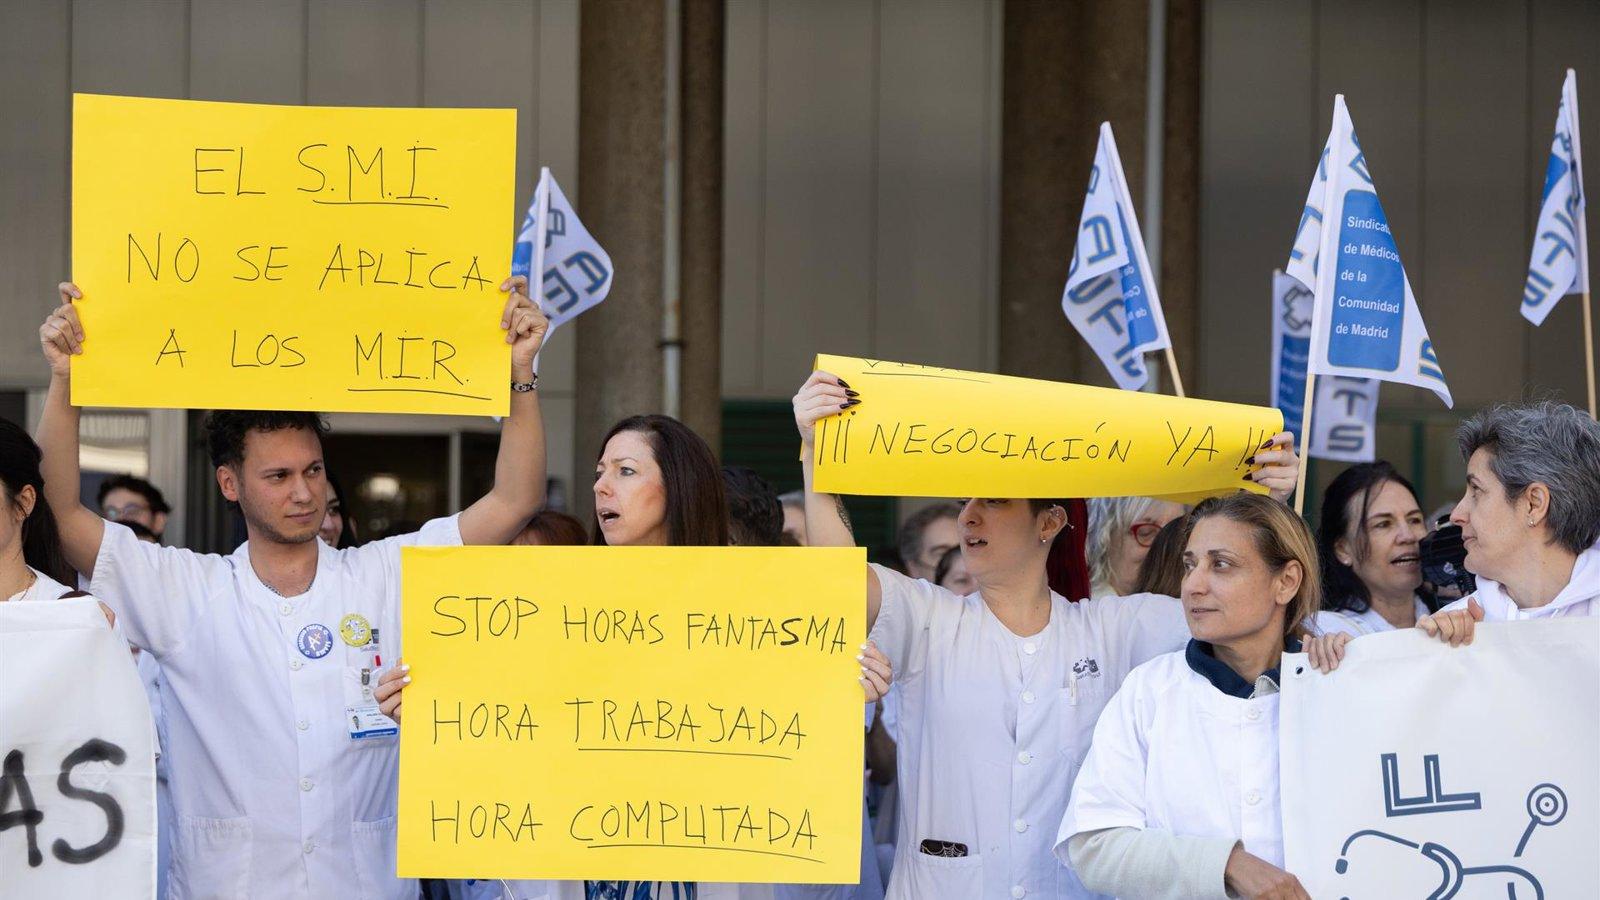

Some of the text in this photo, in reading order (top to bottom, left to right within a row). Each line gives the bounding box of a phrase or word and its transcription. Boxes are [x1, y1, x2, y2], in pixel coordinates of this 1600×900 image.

[195, 147, 266, 196] EL
[128, 233, 199, 283] NO
[234, 245, 288, 281] SE
[319, 244, 493, 291] APLICA
[1341, 269, 1368, 282] de la
[1344, 243, 1400, 262] de Médicos
[1338, 296, 1400, 313] Comunidad
[156, 329, 186, 367] A
[232, 330, 305, 367] LOS
[1335, 323, 1389, 338] de Madrid
[869, 421, 1132, 463] NEGOCIACIÓN
[1166, 420, 1220, 468] YA
[431, 596, 846, 655] STOP HORAS FANTASMA
[434, 700, 539, 744] HORA
[565, 698, 807, 750] TRABAJADA
[432, 800, 818, 850] HORA COMPUTADA
